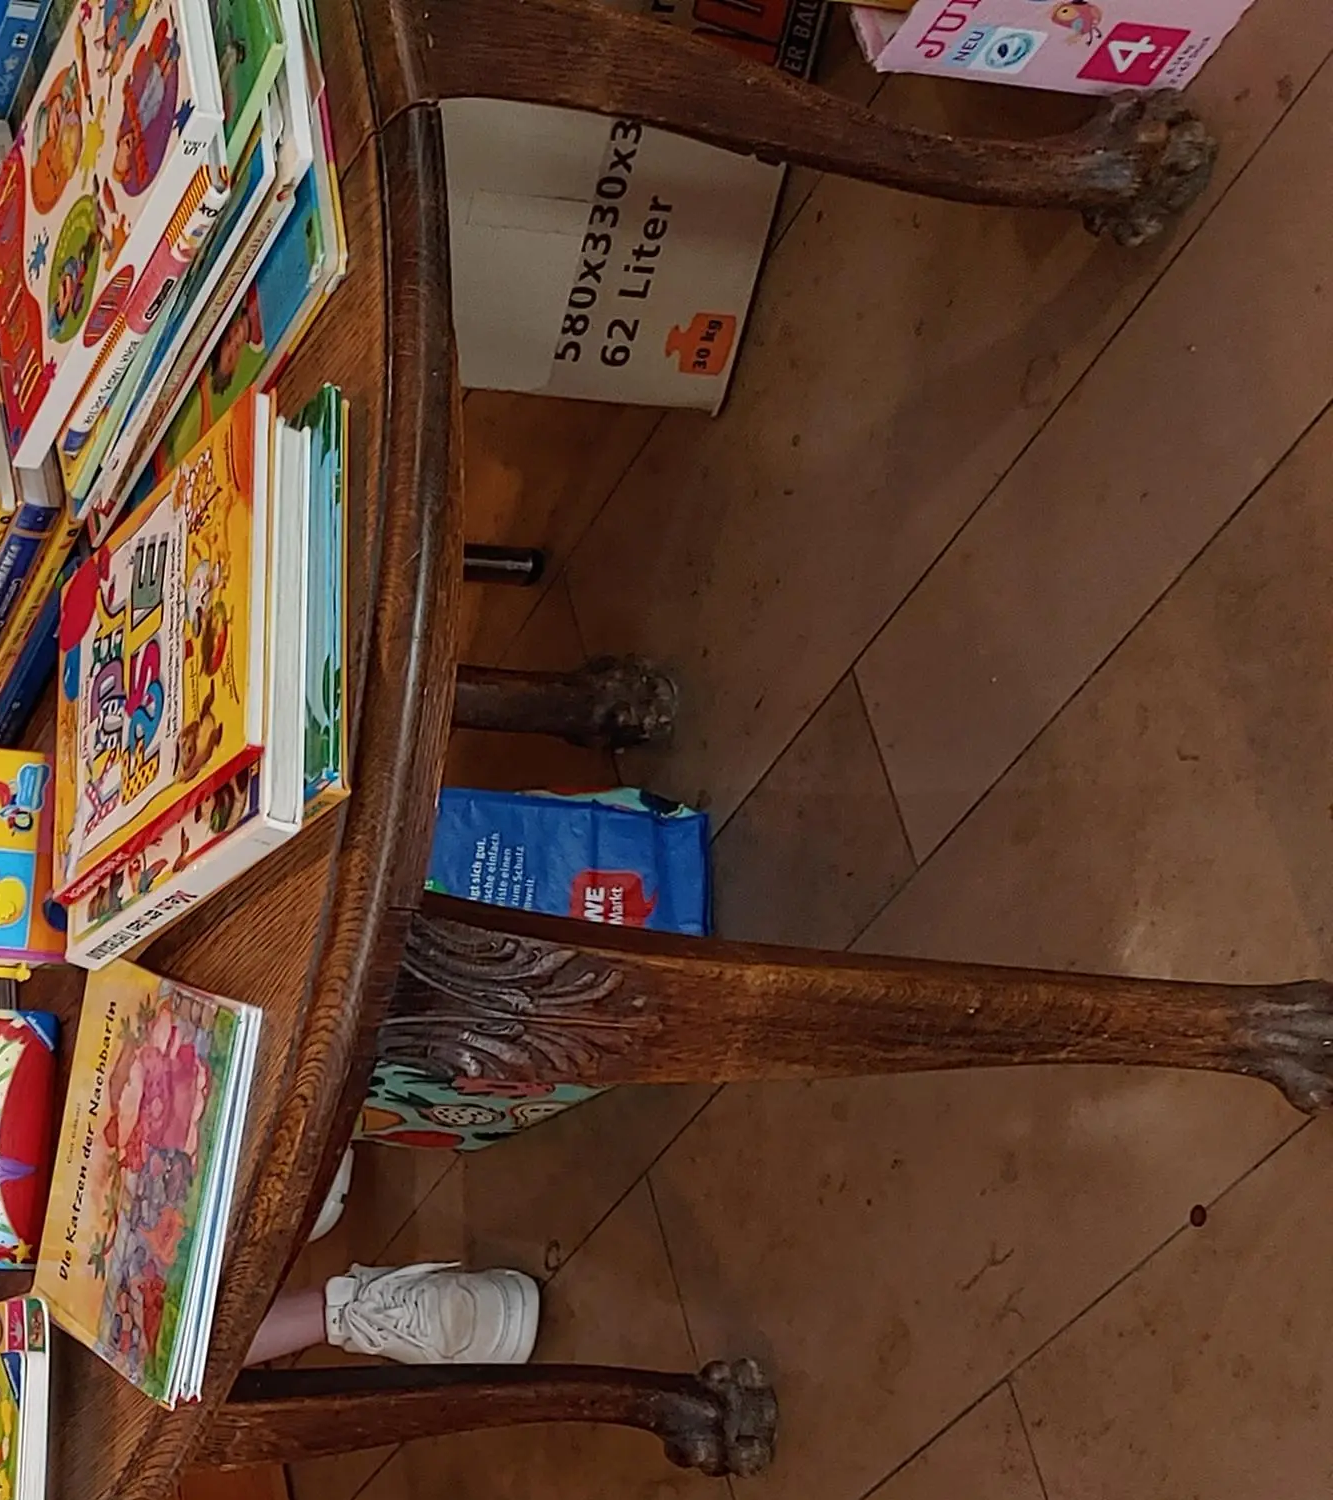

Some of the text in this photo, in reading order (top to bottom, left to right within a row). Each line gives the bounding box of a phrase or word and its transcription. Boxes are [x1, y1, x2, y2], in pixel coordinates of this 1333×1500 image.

[950, 28, 986, 63] NEU
[1107, 35, 1156, 74] 4
[600, 194, 674, 368] 62 Liter
[691, 319, 724, 371] 30 kg
[471, 860, 483, 884] sich
[486, 832, 500, 874] einfach
[500, 847, 512, 879] einen
[511, 845, 525, 906] zum Schutz
[608, 886, 625, 926] Markt
[57, 1000, 118, 1281] Die Katzen der Nachbarin
